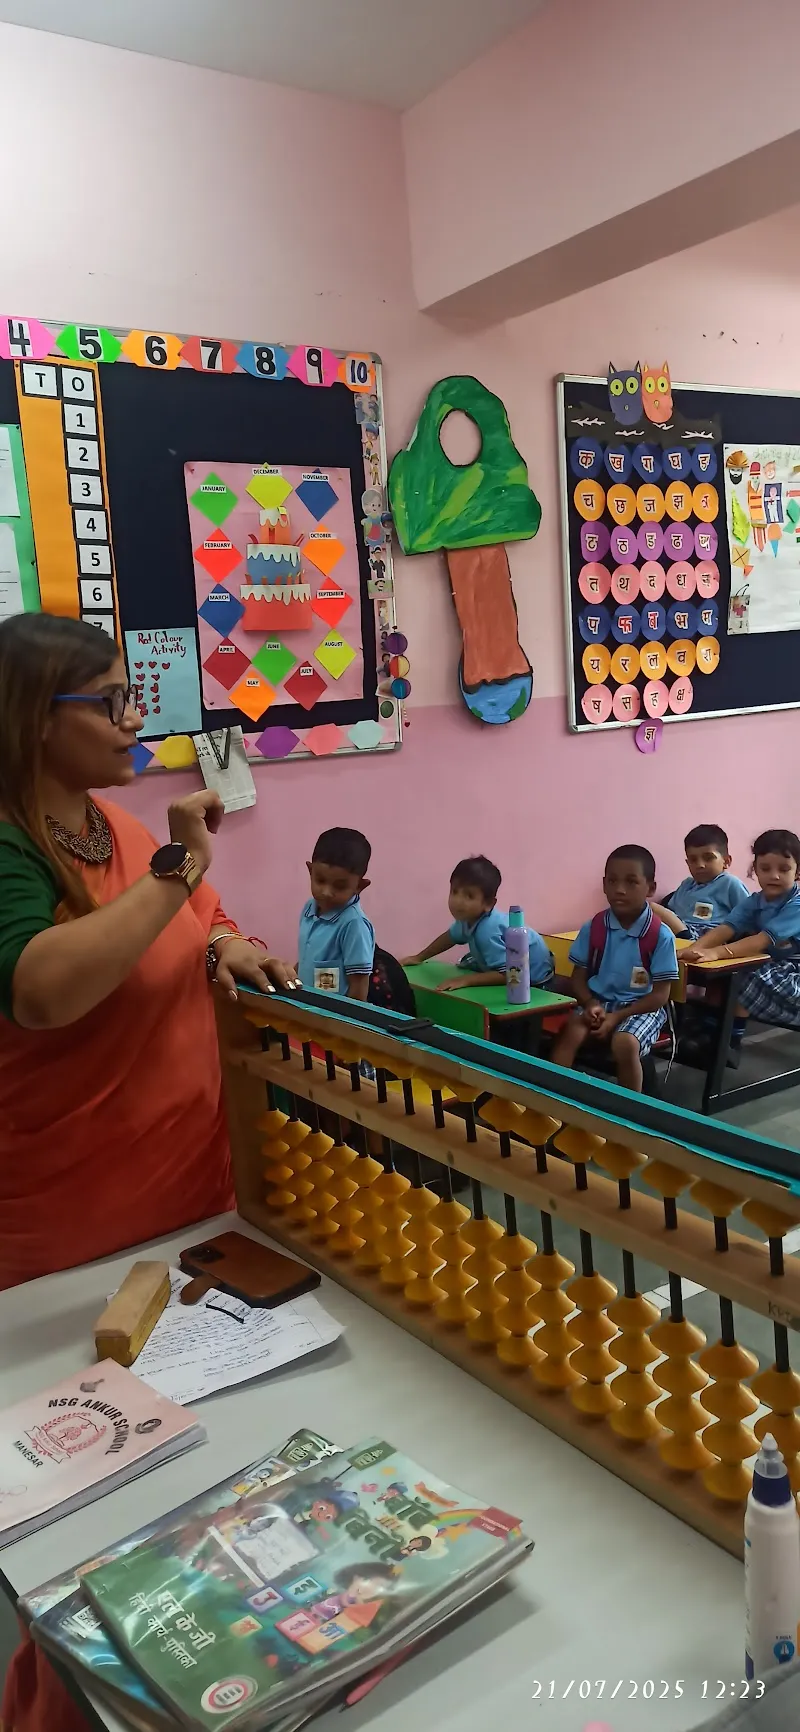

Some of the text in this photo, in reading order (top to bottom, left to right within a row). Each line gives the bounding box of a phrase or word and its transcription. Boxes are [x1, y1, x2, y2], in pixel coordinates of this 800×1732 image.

[8, 319, 368, 384] 4 5 6 7 8 9 10
[34, 372, 46, 388] T
[76, 412, 86, 428] 1
[78, 447, 89, 462] 2
[579, 451, 594, 466] क
[610, 455, 624, 470] ख
[642, 457, 653, 472] ग
[669, 454, 681, 468] घ
[81, 482, 91, 497] 3
[583, 494, 594, 508] च
[615, 499, 626, 513] छ
[644, 499, 656, 512] ज
[673, 494, 684, 509] झ
[86, 517, 97, 532] 4
[618, 540, 629, 554] ठ
[646, 534, 655, 548] ड
[672, 535, 682, 549] ढ
[91, 552, 101, 567] 5
[589, 577, 599, 591] त
[619, 577, 630, 591] थ
[648, 575, 656, 588] द
[676, 574, 686, 587] ध
[92, 587, 103, 602] 6
[588, 611, 712, 633] प फ ब भ म
[154, 631, 183, 644] Colour
[151, 642, 187, 658] Activity
[590, 658, 600, 671] य
[621, 658, 629, 672] र
[648, 654, 658, 668] ल
[677, 651, 686, 664] व
[592, 688, 685, 713] ष स ह क्ष
[48, 1397, 130, 1456] NSG ANKUR SCHOOL
[13, 1440, 44, 1468] MANESAR
[175, 1612, 198, 1633] के
[189, 1627, 217, 1651] जी
